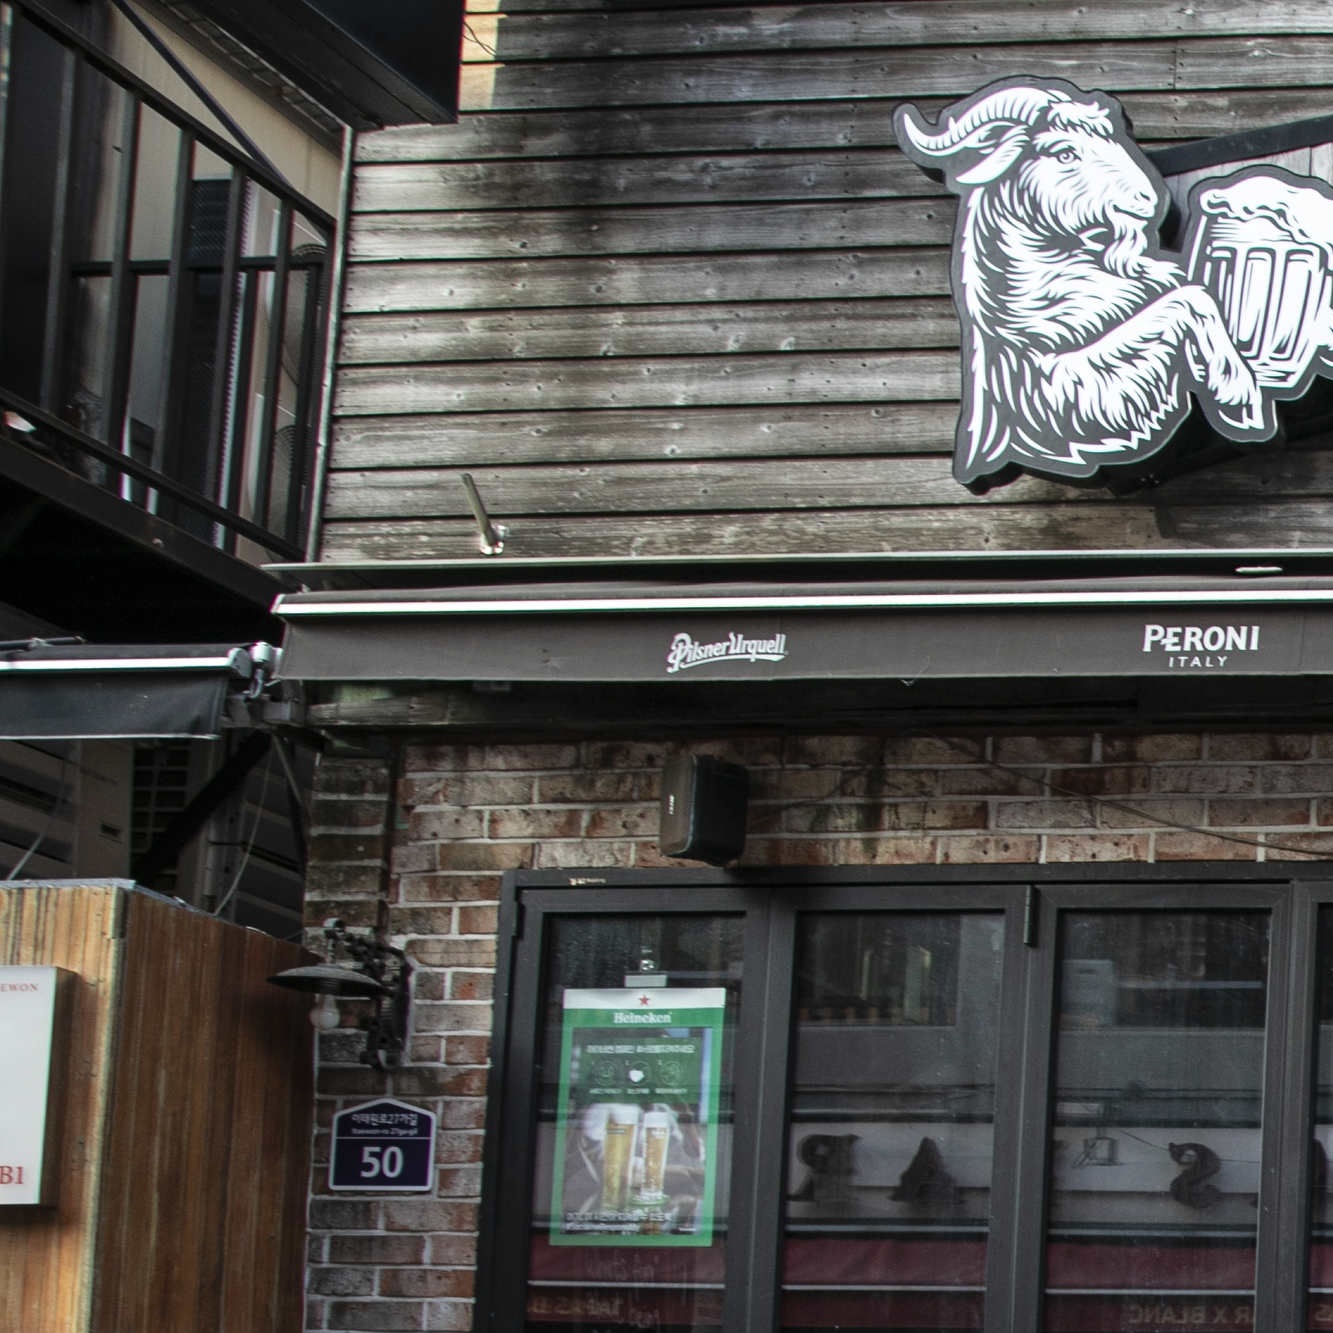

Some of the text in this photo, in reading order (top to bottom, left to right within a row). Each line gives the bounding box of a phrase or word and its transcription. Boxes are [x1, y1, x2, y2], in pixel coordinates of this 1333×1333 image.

[667, 631, 788, 673] Pilsner Urquell
[1143, 624, 1260, 652] PERONI
[1168, 656, 1228, 668] ITALY
[613, 1012, 672, 1024] Heineken
[360, 1145, 404, 1178] 50
